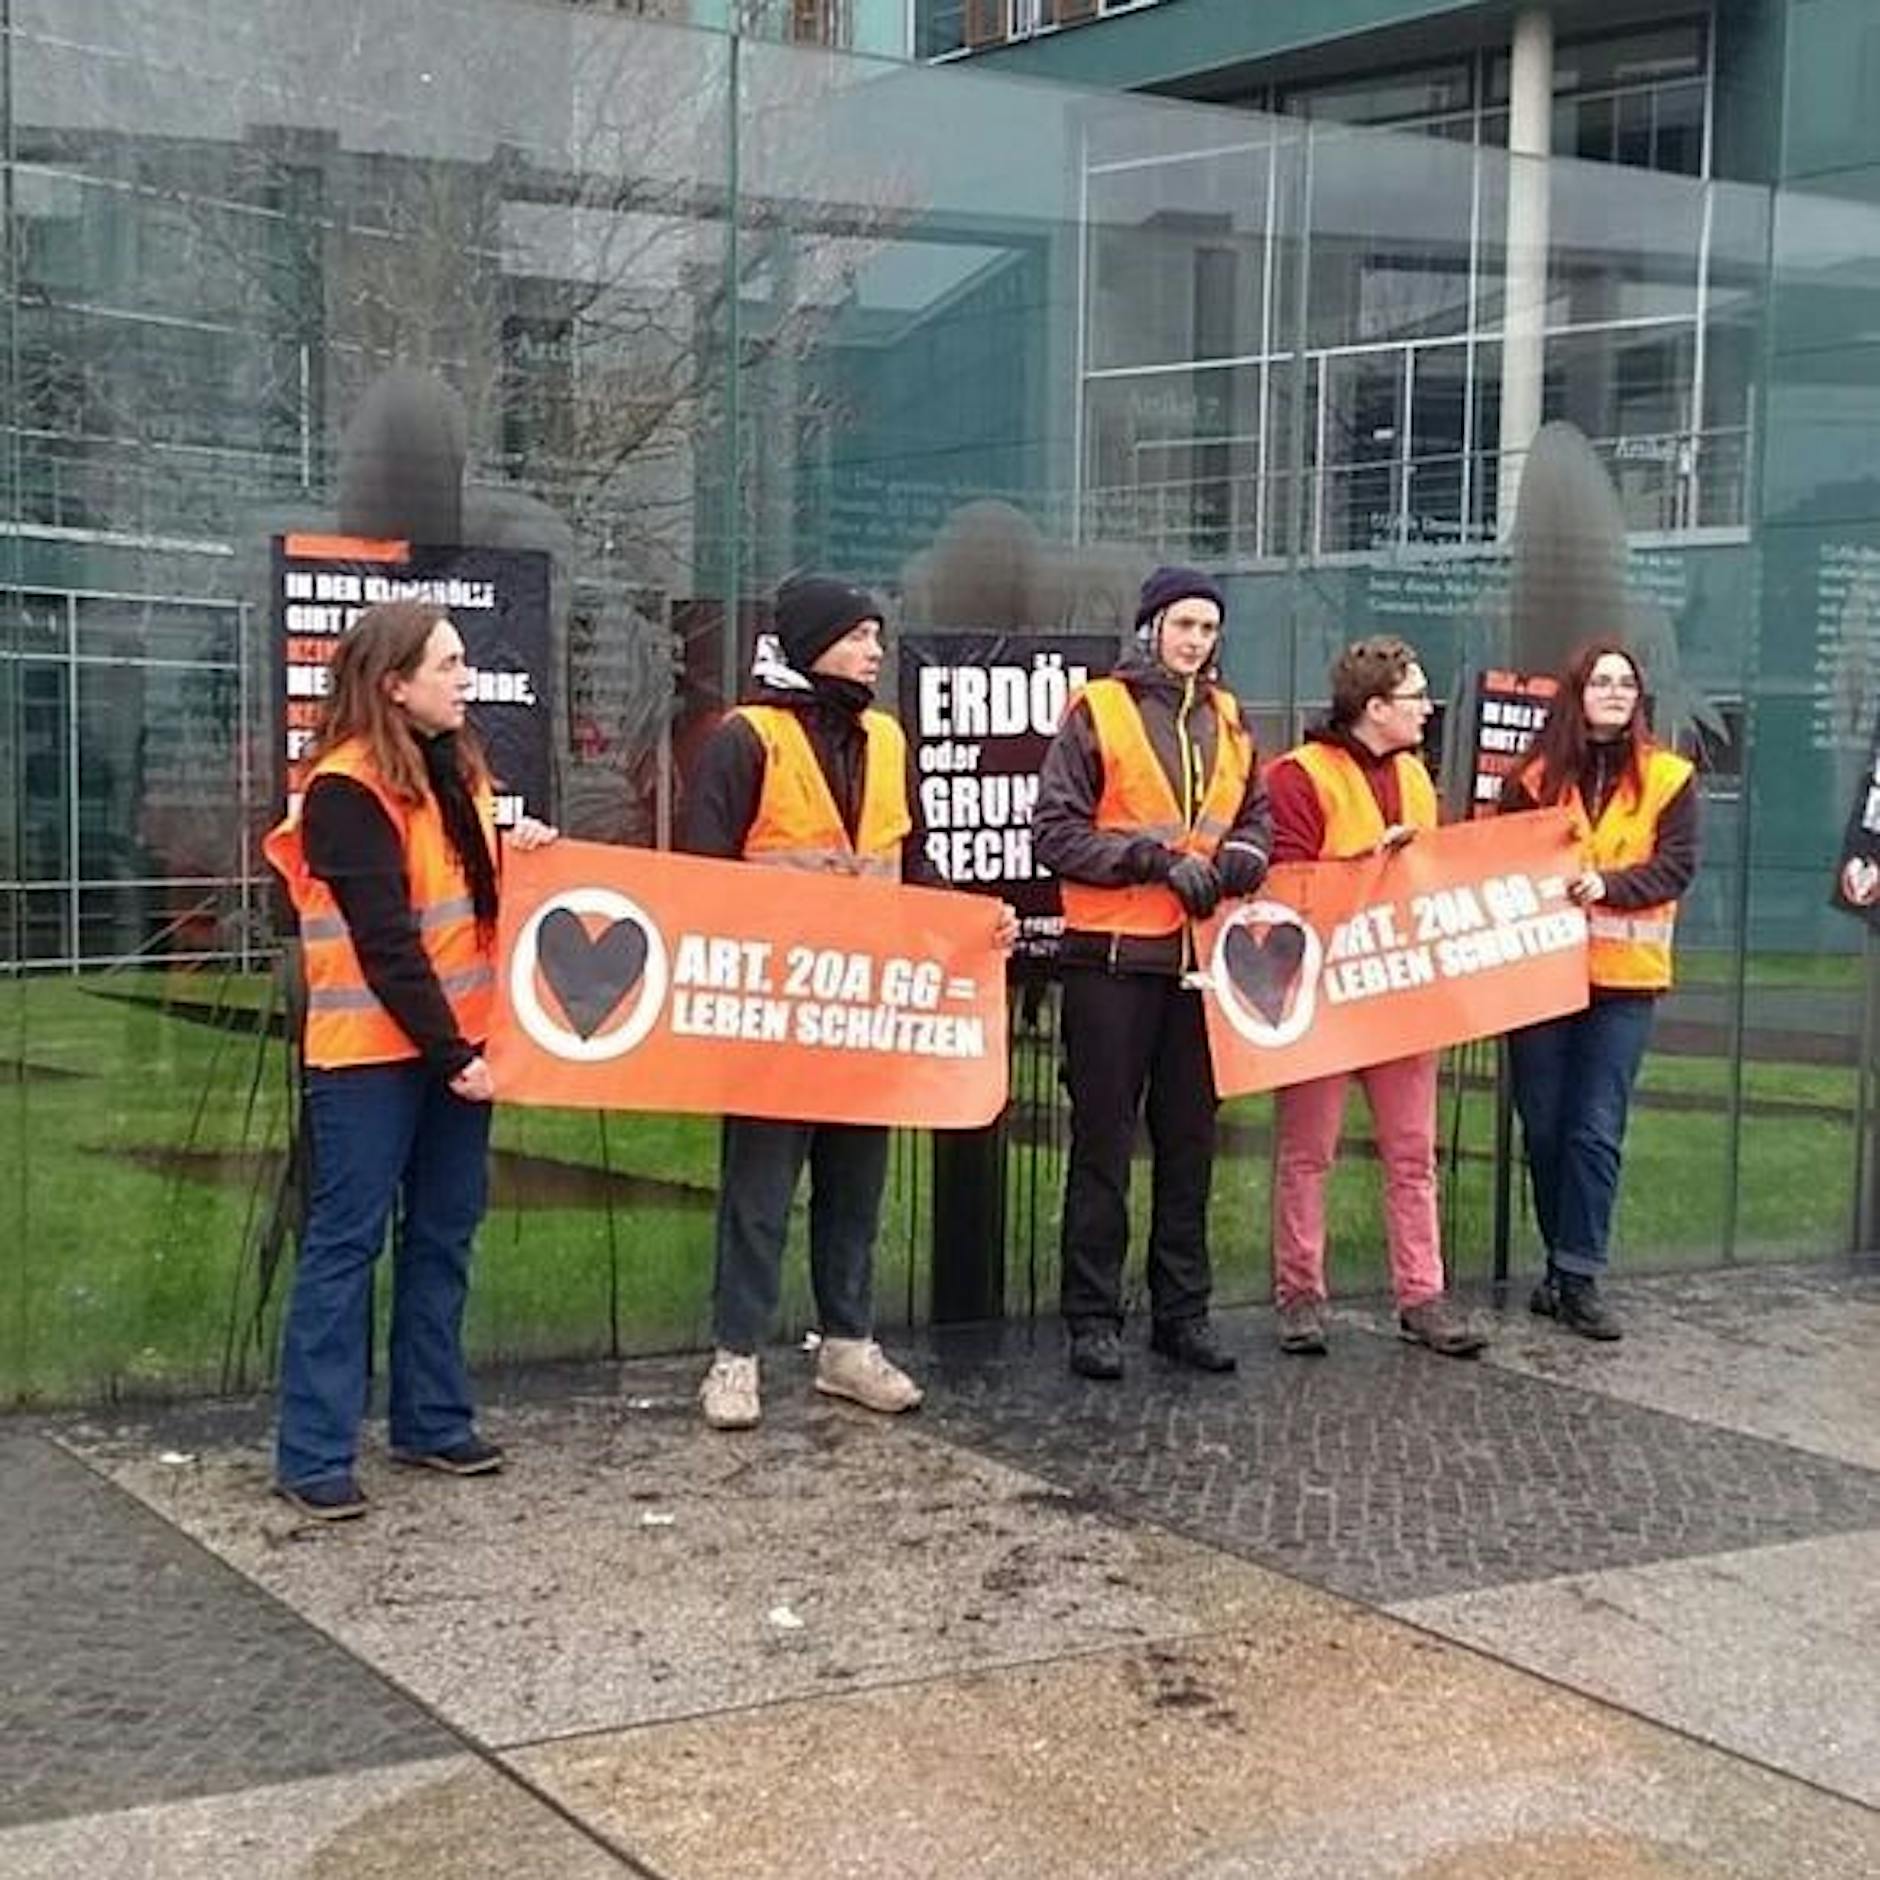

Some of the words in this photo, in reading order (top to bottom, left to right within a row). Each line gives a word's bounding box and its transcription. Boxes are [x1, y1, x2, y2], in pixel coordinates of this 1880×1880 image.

[316, 574, 361, 601] DER
[919, 740, 981, 773] oder
[920, 773, 1040, 828] GRUN
[925, 828, 1052, 882] RECH
[1412, 887, 1489, 942] 20A
[673, 935, 773, 993] ART.
[785, 947, 873, 1001] 20A
[880, 958, 943, 1010] GG
[1324, 944, 1436, 1005] LEBEN
[671, 990, 790, 1043] LEBEN
[796, 1001, 985, 1058] SCHÜTZEN
